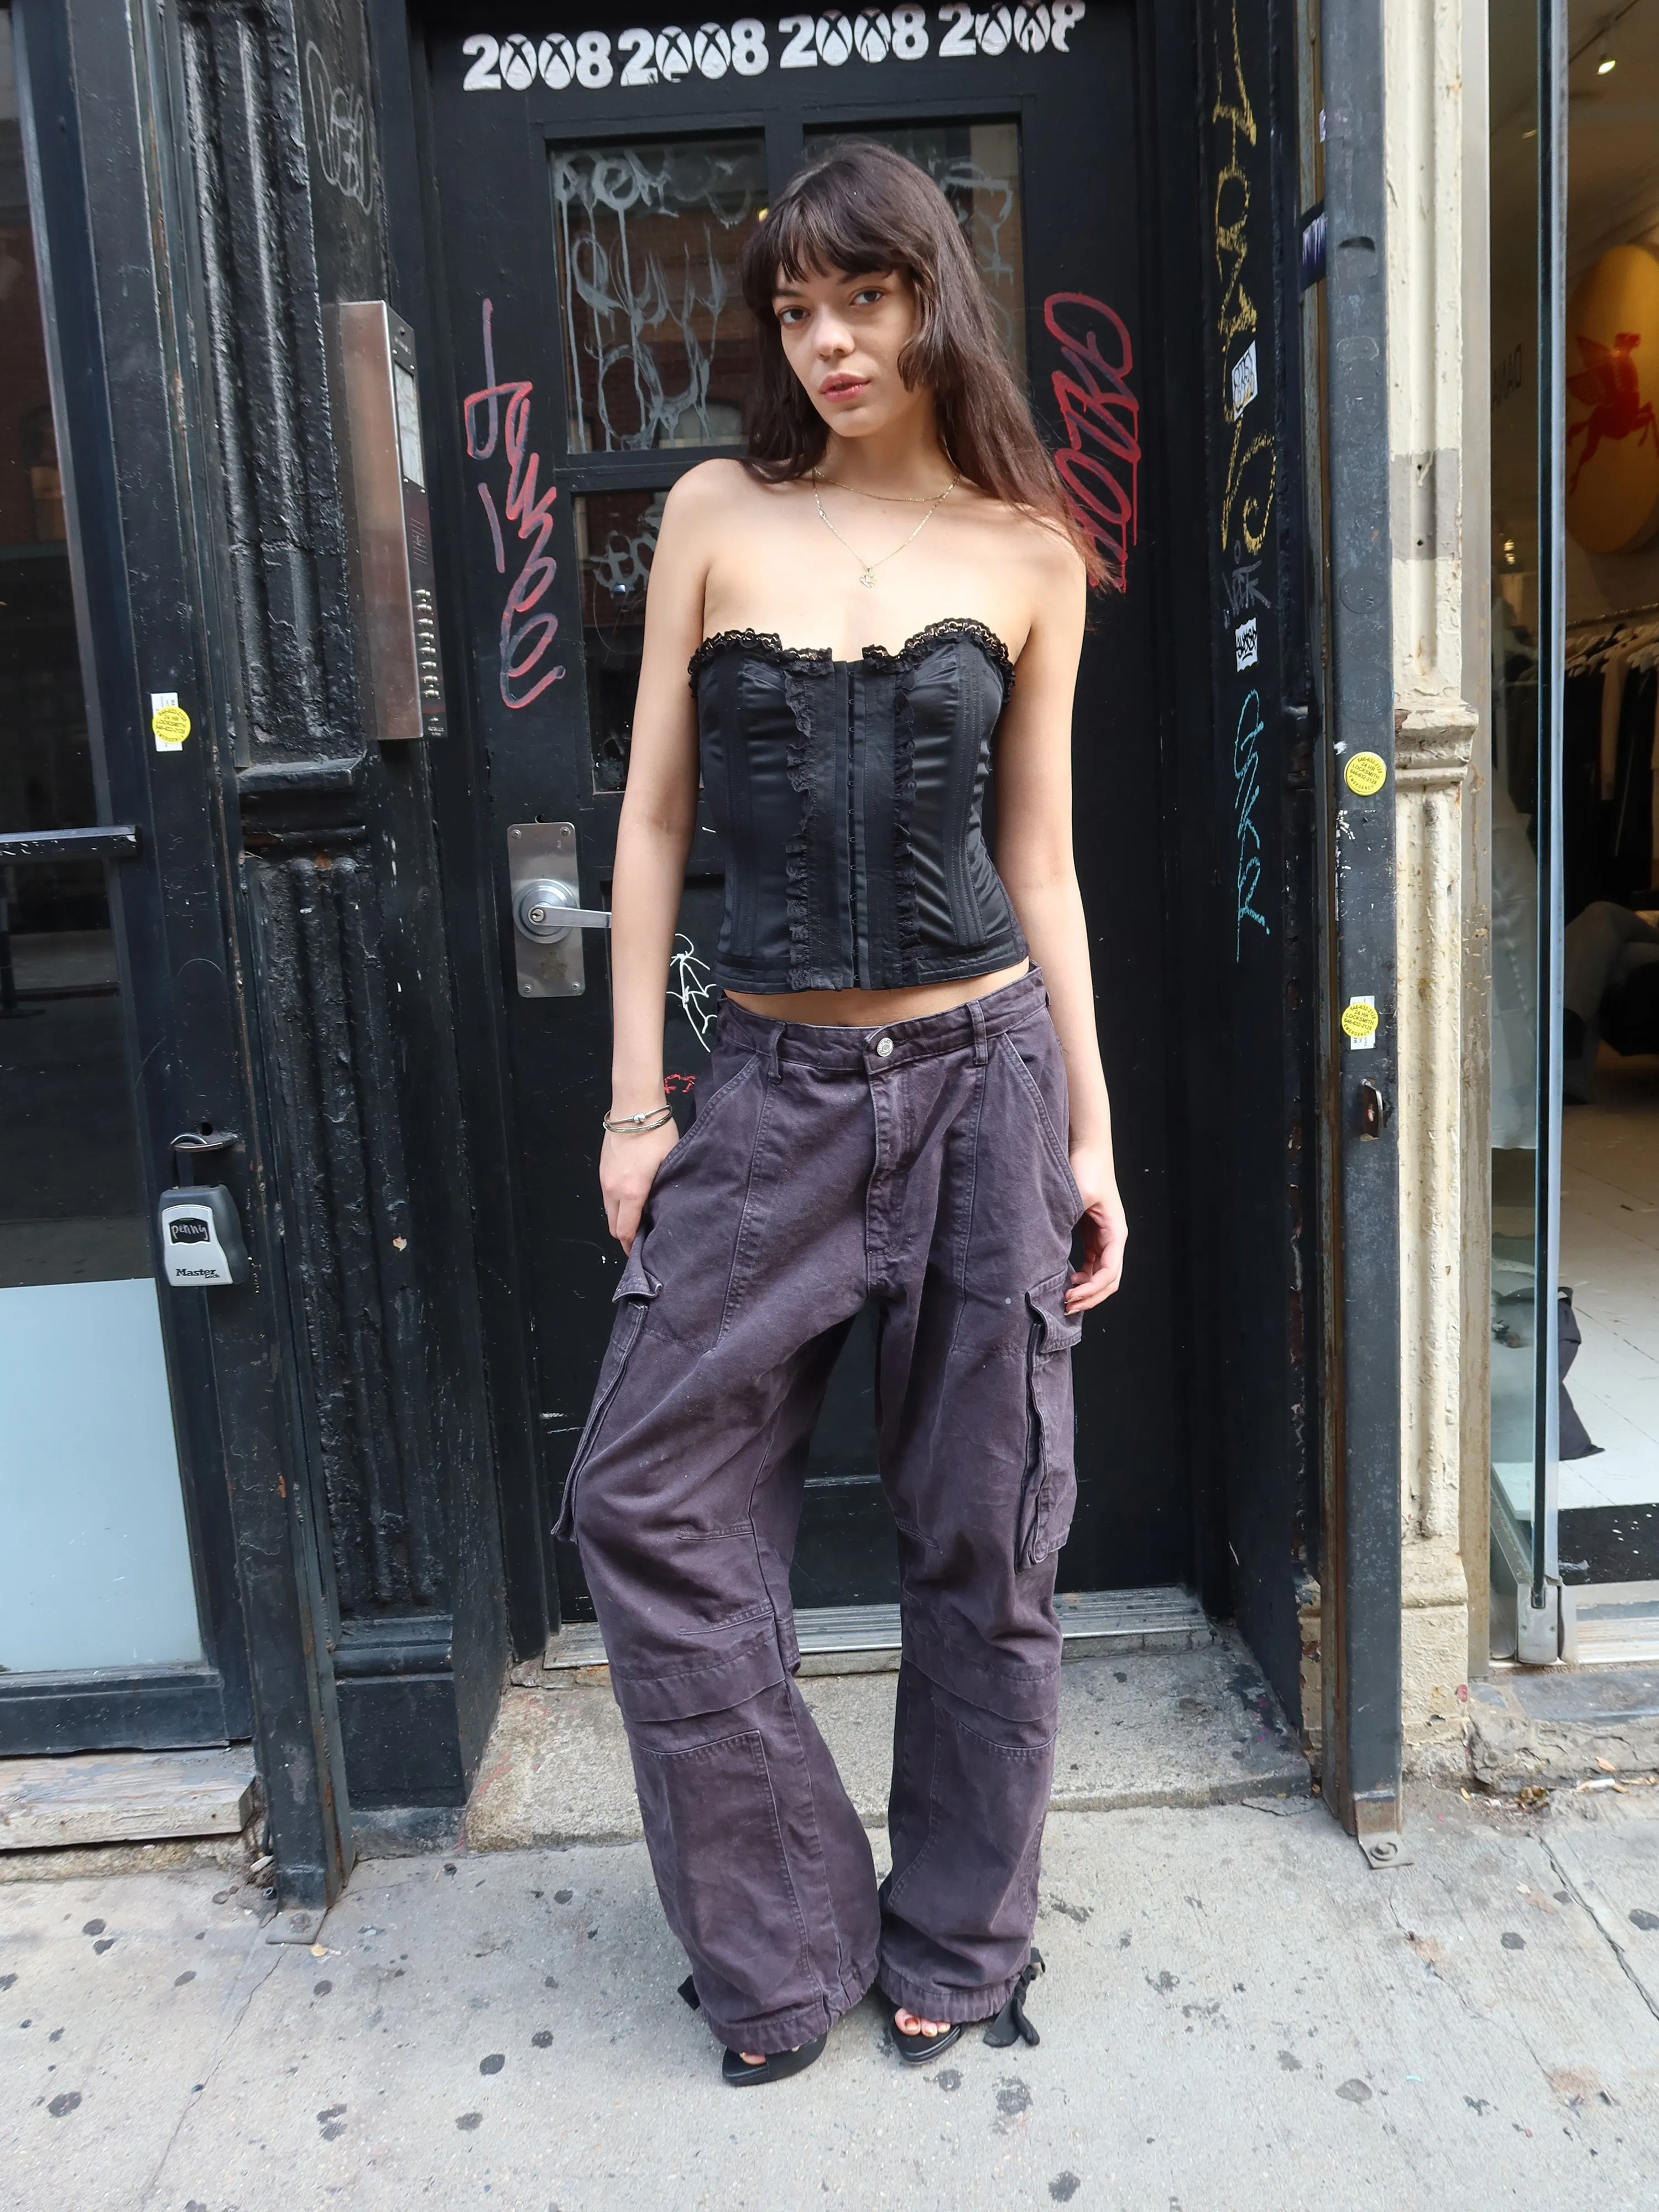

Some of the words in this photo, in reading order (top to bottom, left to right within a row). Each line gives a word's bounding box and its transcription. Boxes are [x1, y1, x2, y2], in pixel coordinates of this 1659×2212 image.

[1352, 764, 1379, 779] LOCKSMITH
[1349, 775, 1374, 790] EMERGENCY
[1345, 1013, 1374, 1025] LOCKSMITH
[1344, 1024, 1370, 1036] EMERGENCY
[176, 1268, 217, 1276] Master
